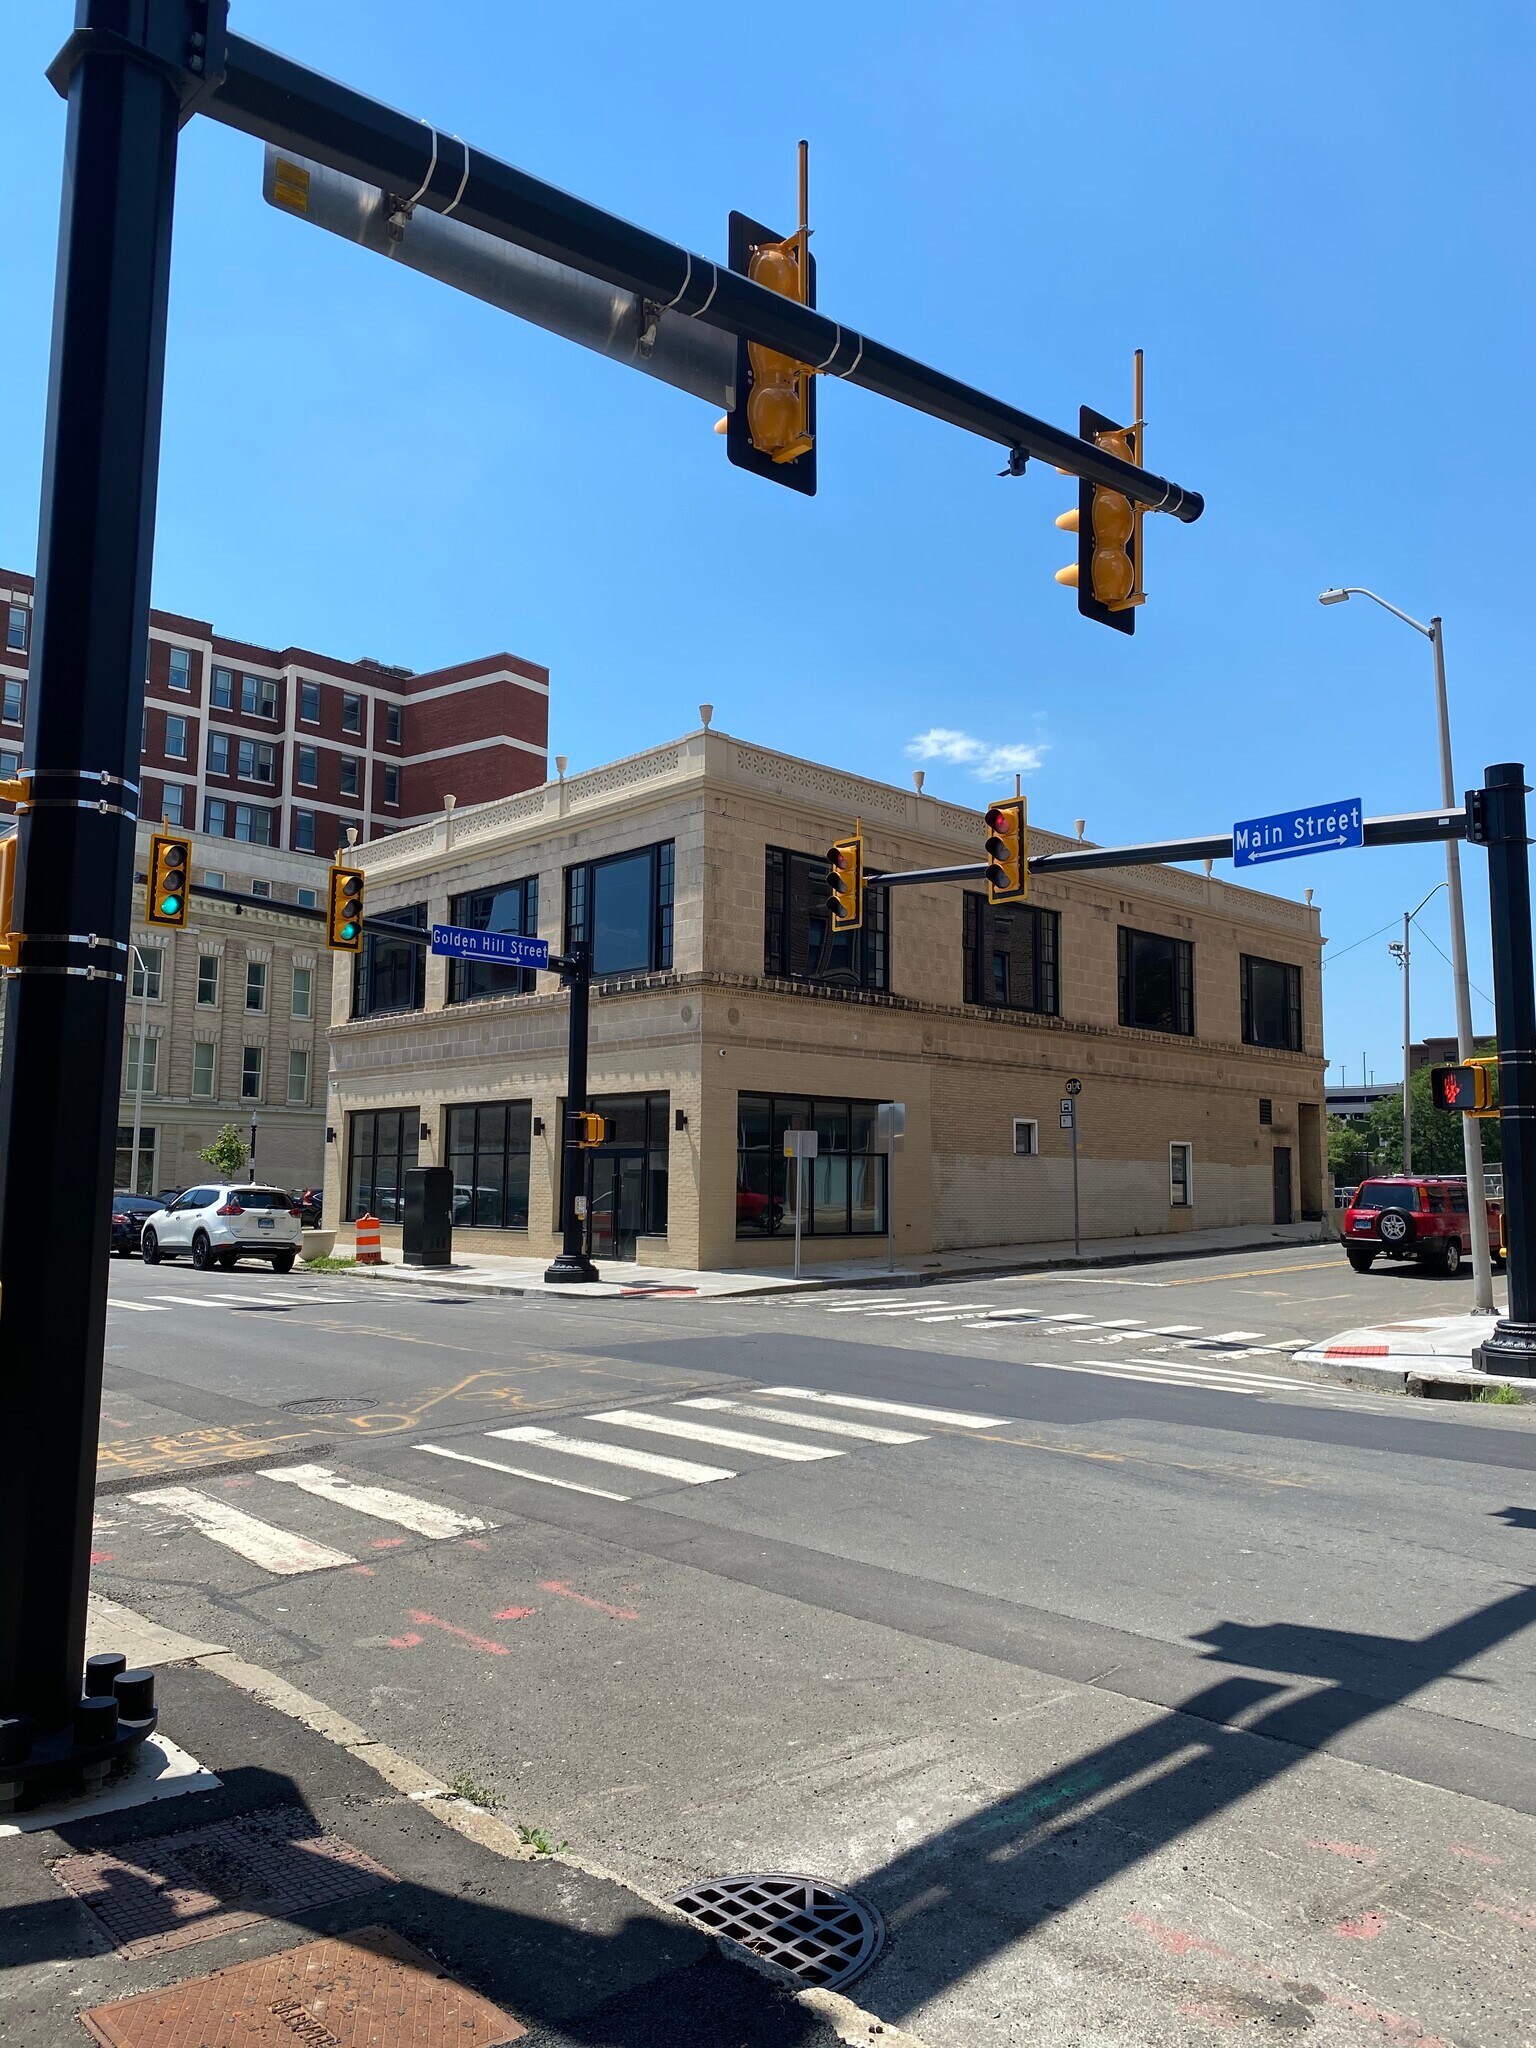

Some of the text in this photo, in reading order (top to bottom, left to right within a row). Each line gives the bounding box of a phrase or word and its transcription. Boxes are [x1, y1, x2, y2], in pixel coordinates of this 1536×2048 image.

[1236, 807, 1359, 850] Main Street
[433, 930, 548, 958] Golden Hill Street
